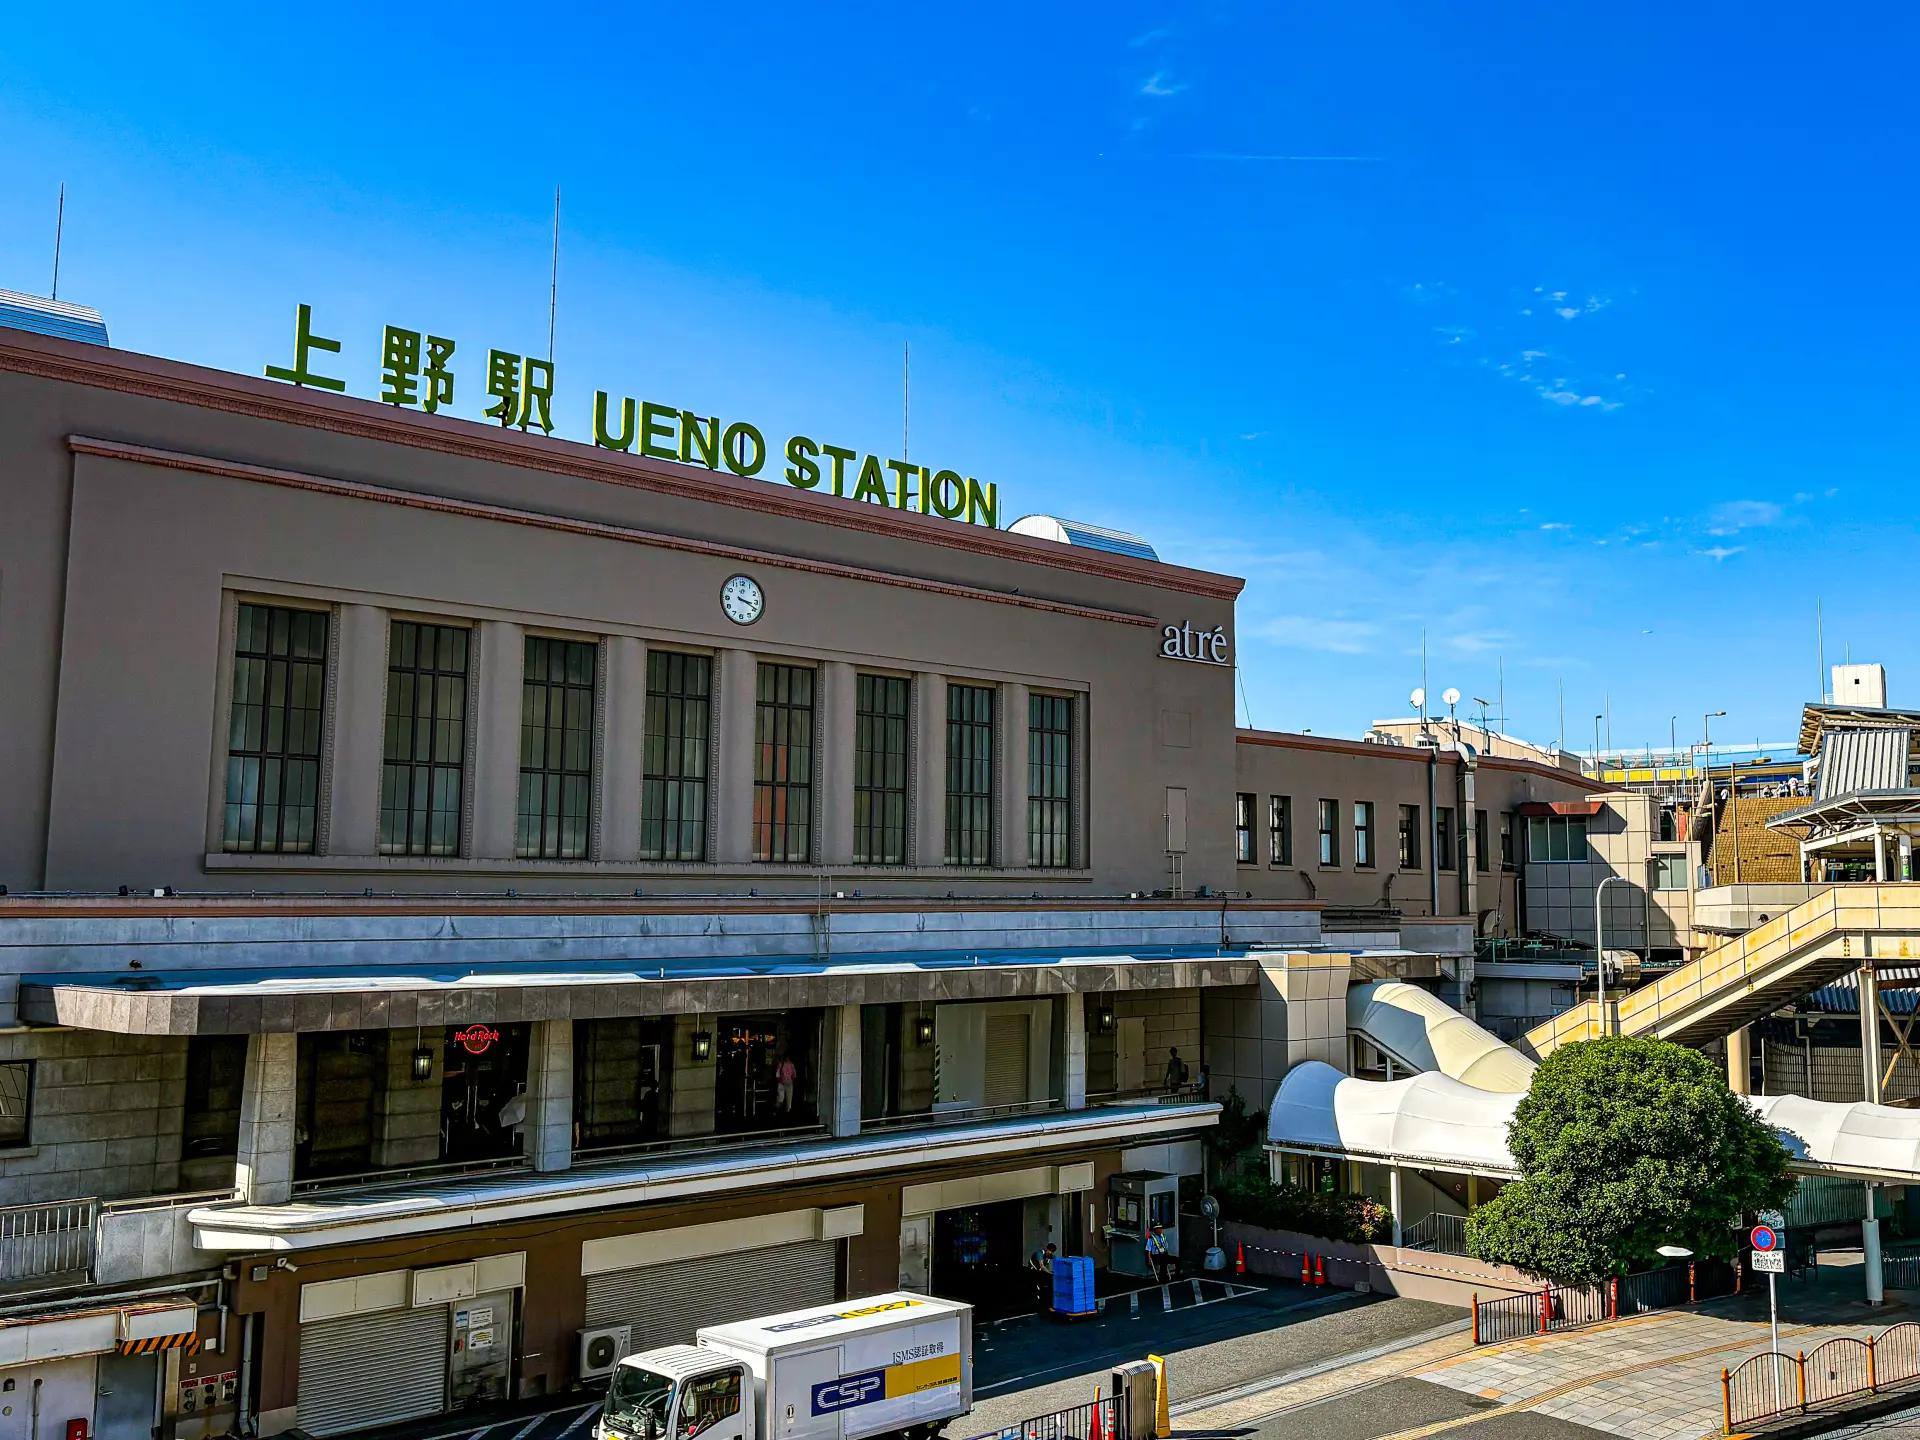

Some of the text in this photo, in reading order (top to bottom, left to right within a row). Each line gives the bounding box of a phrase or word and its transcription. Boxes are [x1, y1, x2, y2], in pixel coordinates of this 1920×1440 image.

[264, 303, 998, 528] 上野駅 UENO STATION
[1163, 620, 1228, 663] atré
[454, 1029, 499, 1042] Hard Rock
[892, 1341, 945, 1364] ISMS認証取得
[817, 1376, 881, 1409] CSP
